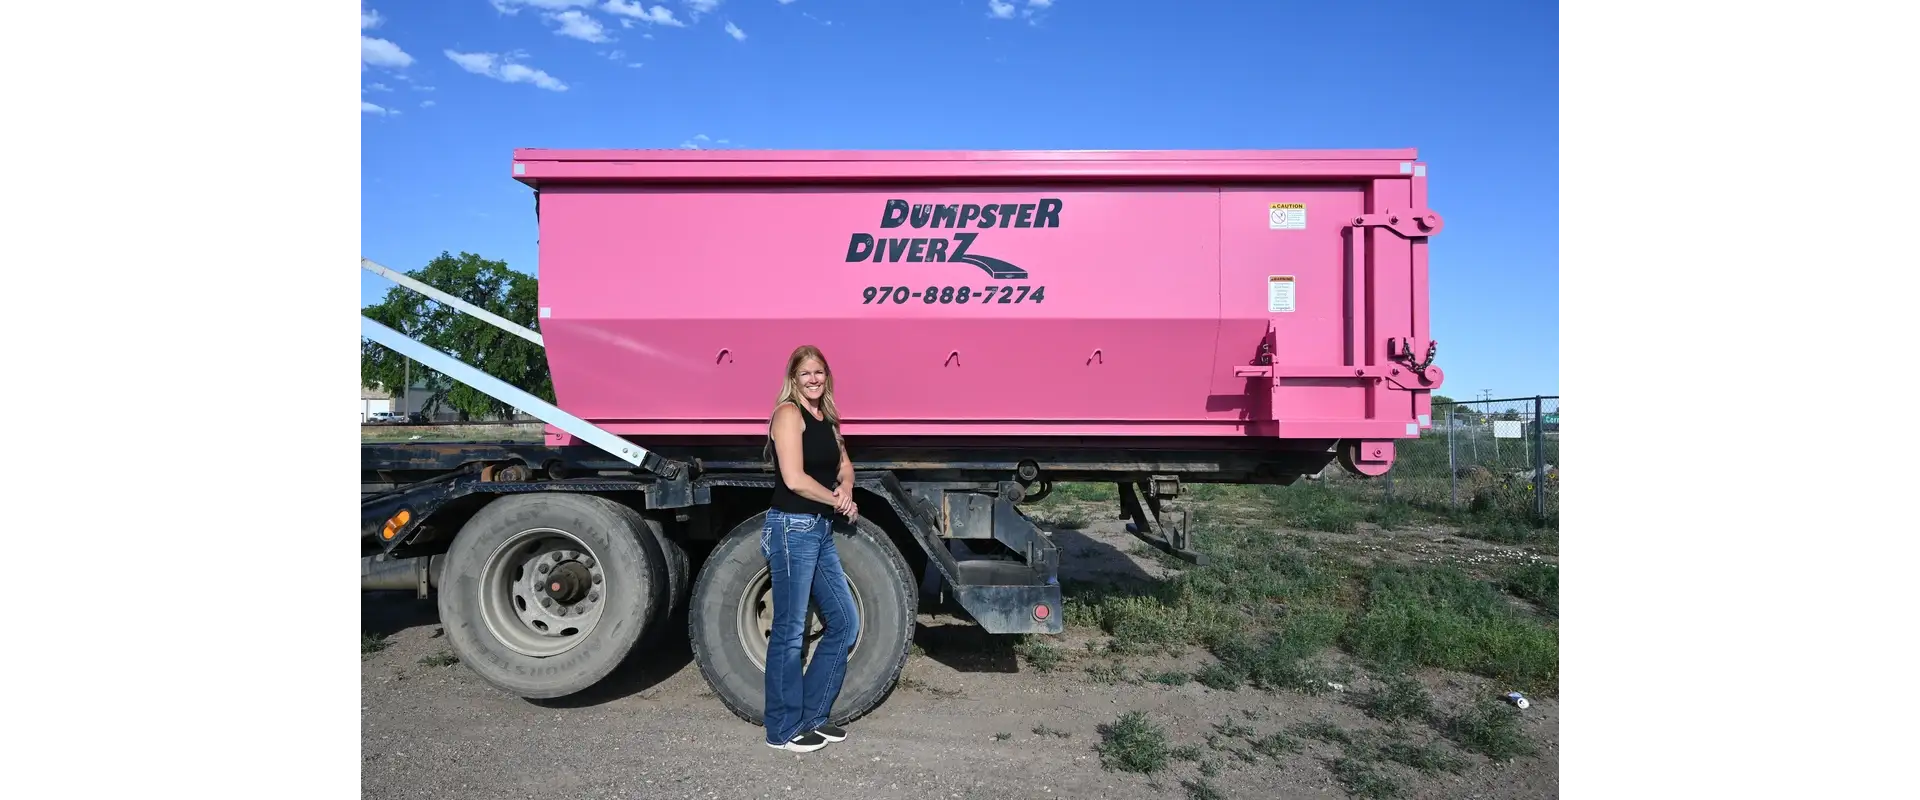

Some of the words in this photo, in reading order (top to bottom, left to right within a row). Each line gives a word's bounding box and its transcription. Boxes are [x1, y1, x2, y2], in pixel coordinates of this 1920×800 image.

[880, 199, 1063, 229] DUMPSTER
[845, 233, 986, 264] DIVERZ
[862, 286, 1045, 304] 970-888-7274
